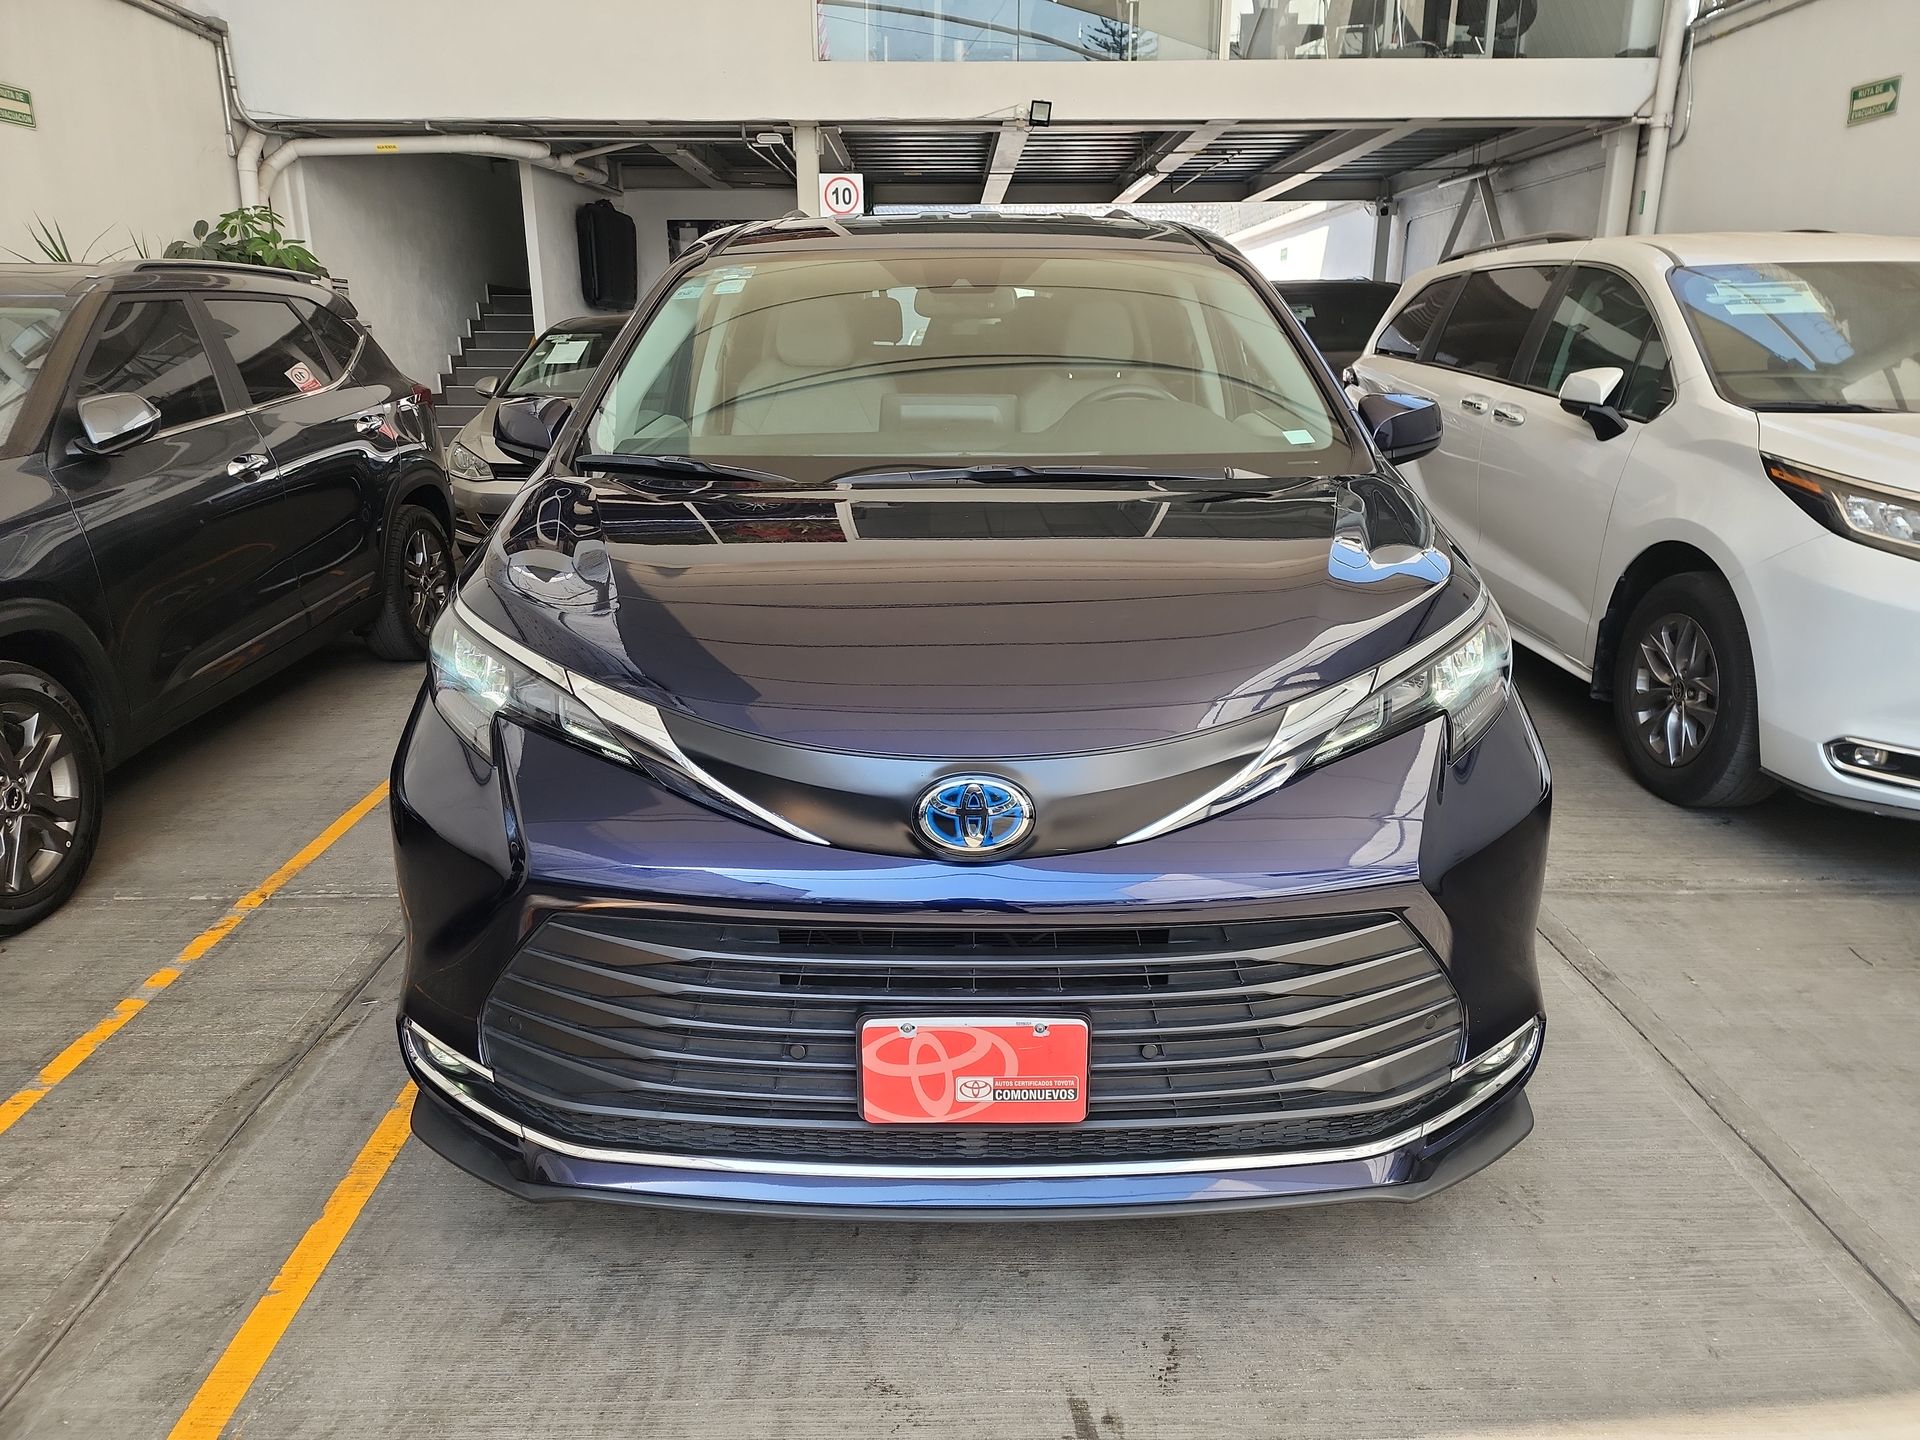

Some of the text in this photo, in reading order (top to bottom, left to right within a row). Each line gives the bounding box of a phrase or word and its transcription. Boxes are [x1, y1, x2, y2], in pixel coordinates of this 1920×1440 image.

[1875, 84, 1884, 94] DE
[15, 91, 24, 101] DE
[832, 187, 852, 205] 10
[995, 1089, 1075, 1100] COMONUEVOS
